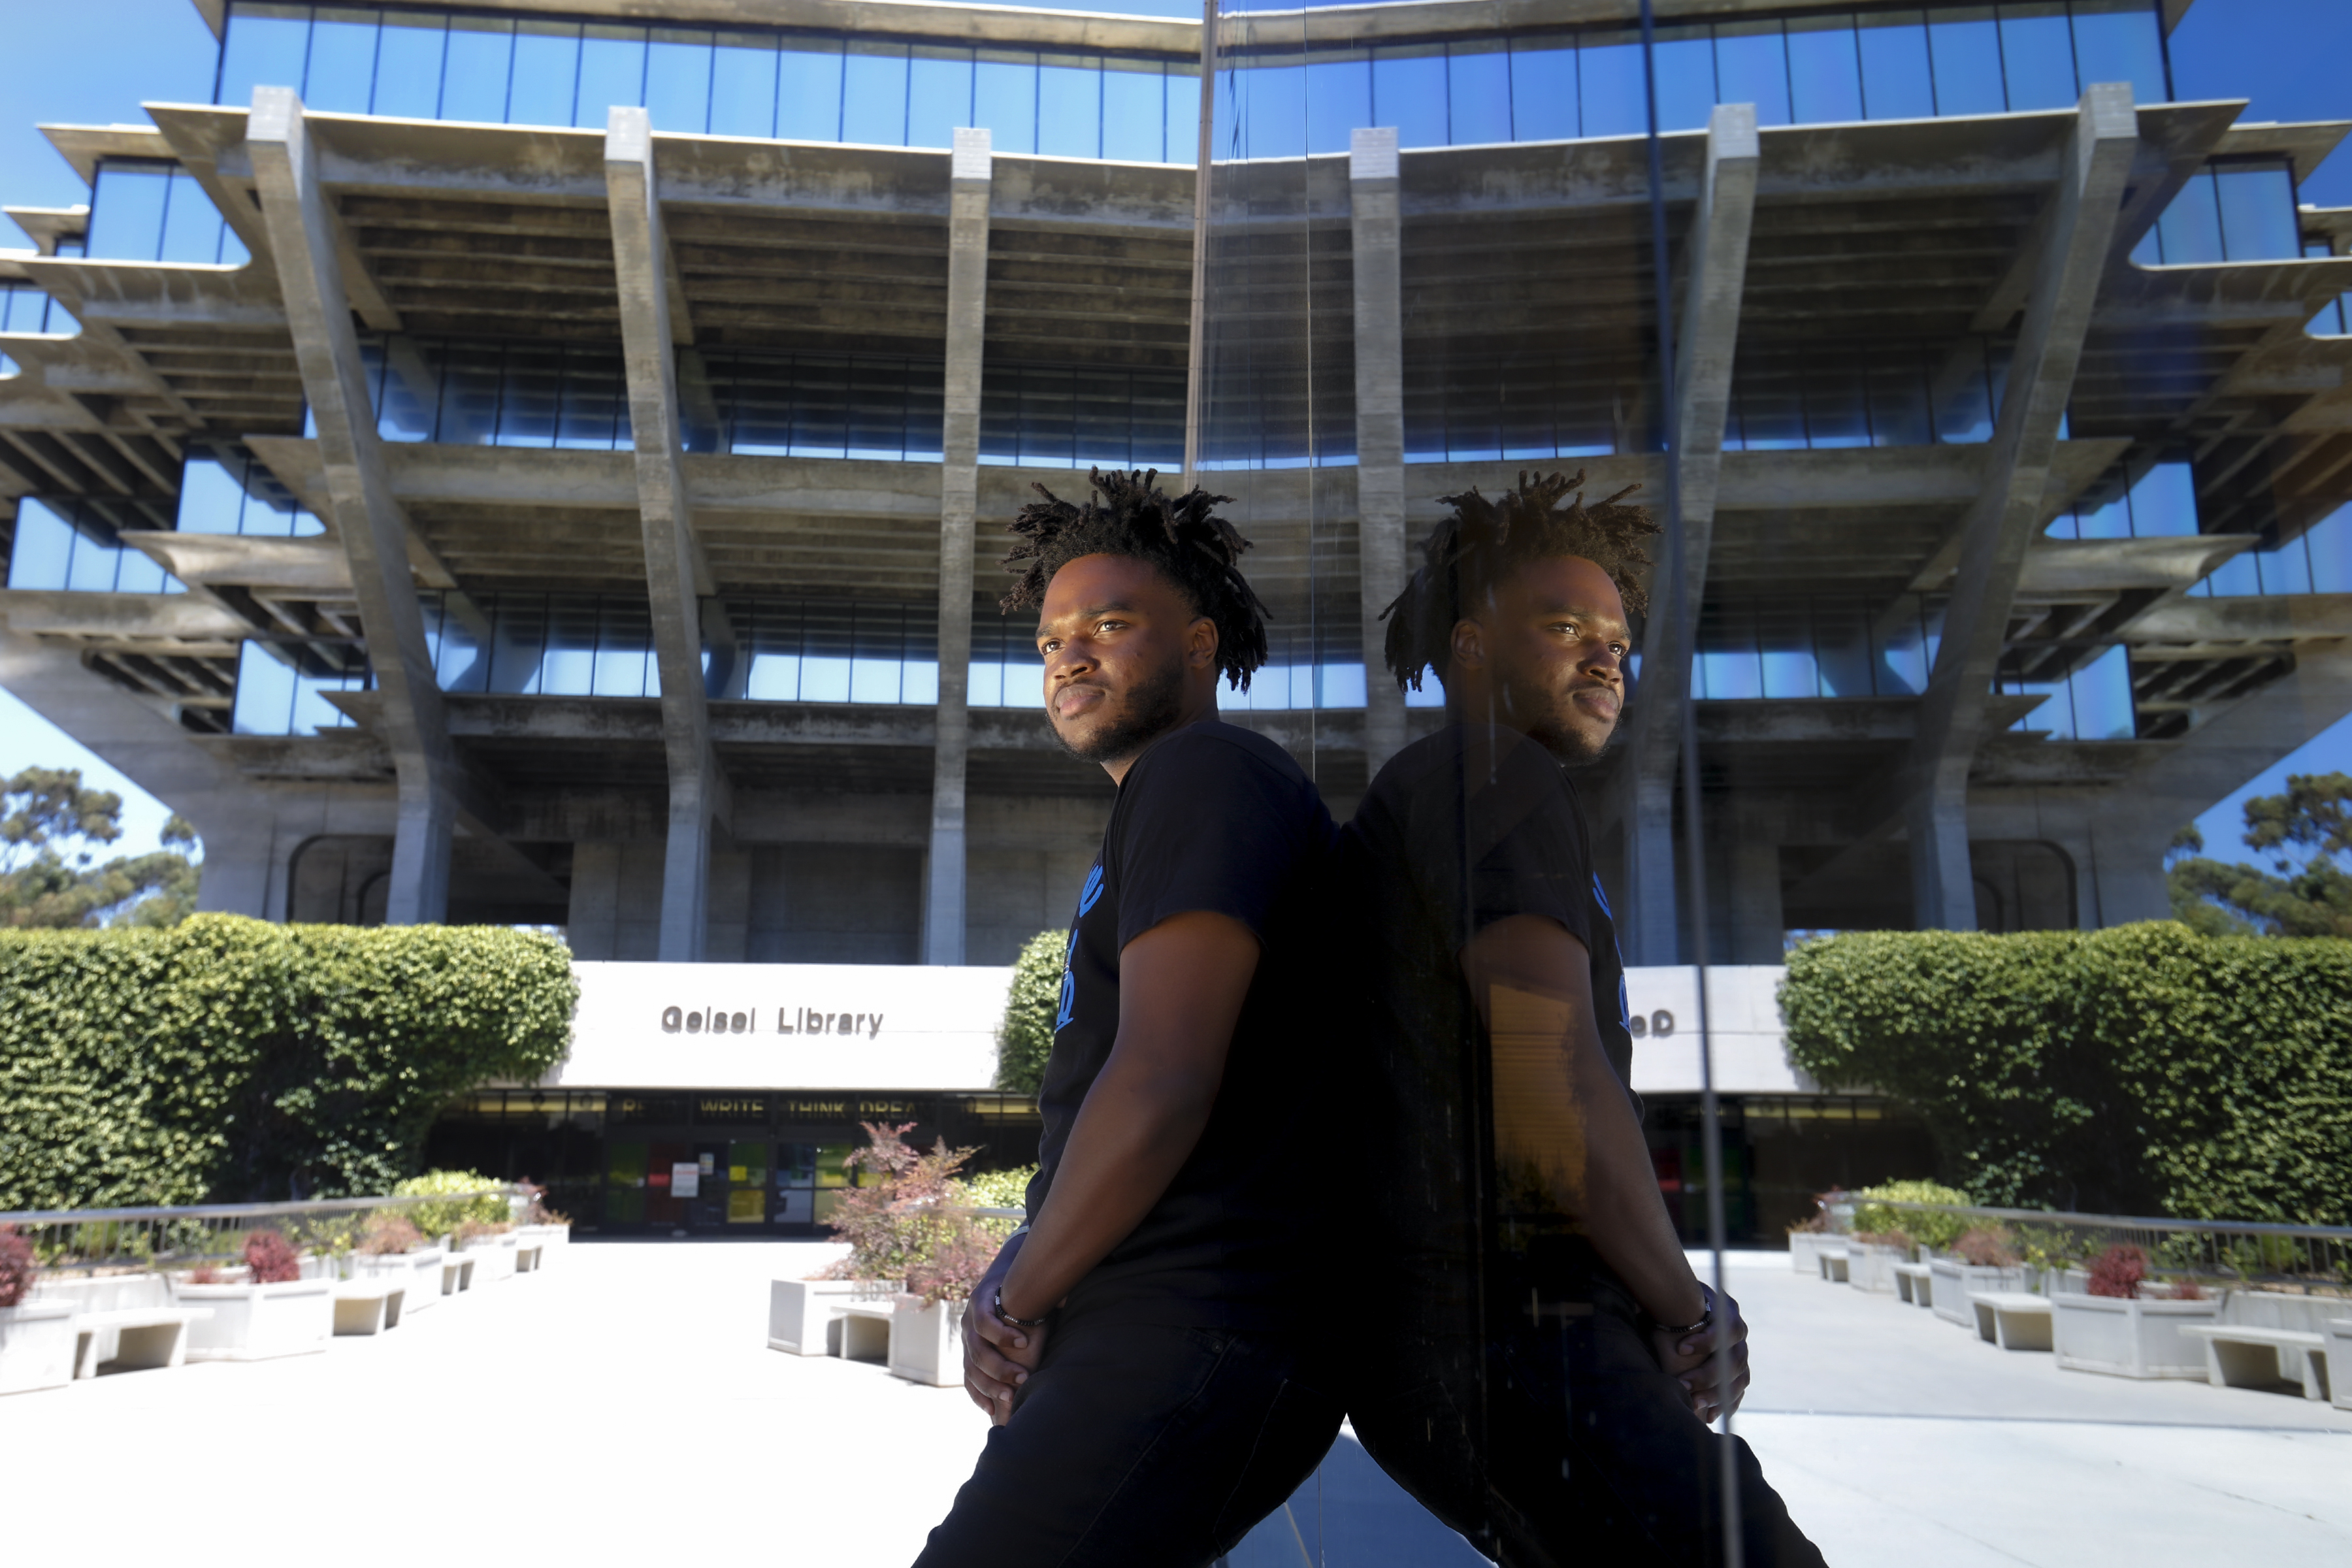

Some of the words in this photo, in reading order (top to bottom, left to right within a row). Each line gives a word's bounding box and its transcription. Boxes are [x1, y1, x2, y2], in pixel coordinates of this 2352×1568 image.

[661, 1005, 755, 1034] Geisel
[777, 1007, 884, 1040] Library
[700, 1099, 764, 1119] WRITE
[787, 1100, 846, 1119] THINK
[859, 1100, 935, 1119] DREA
